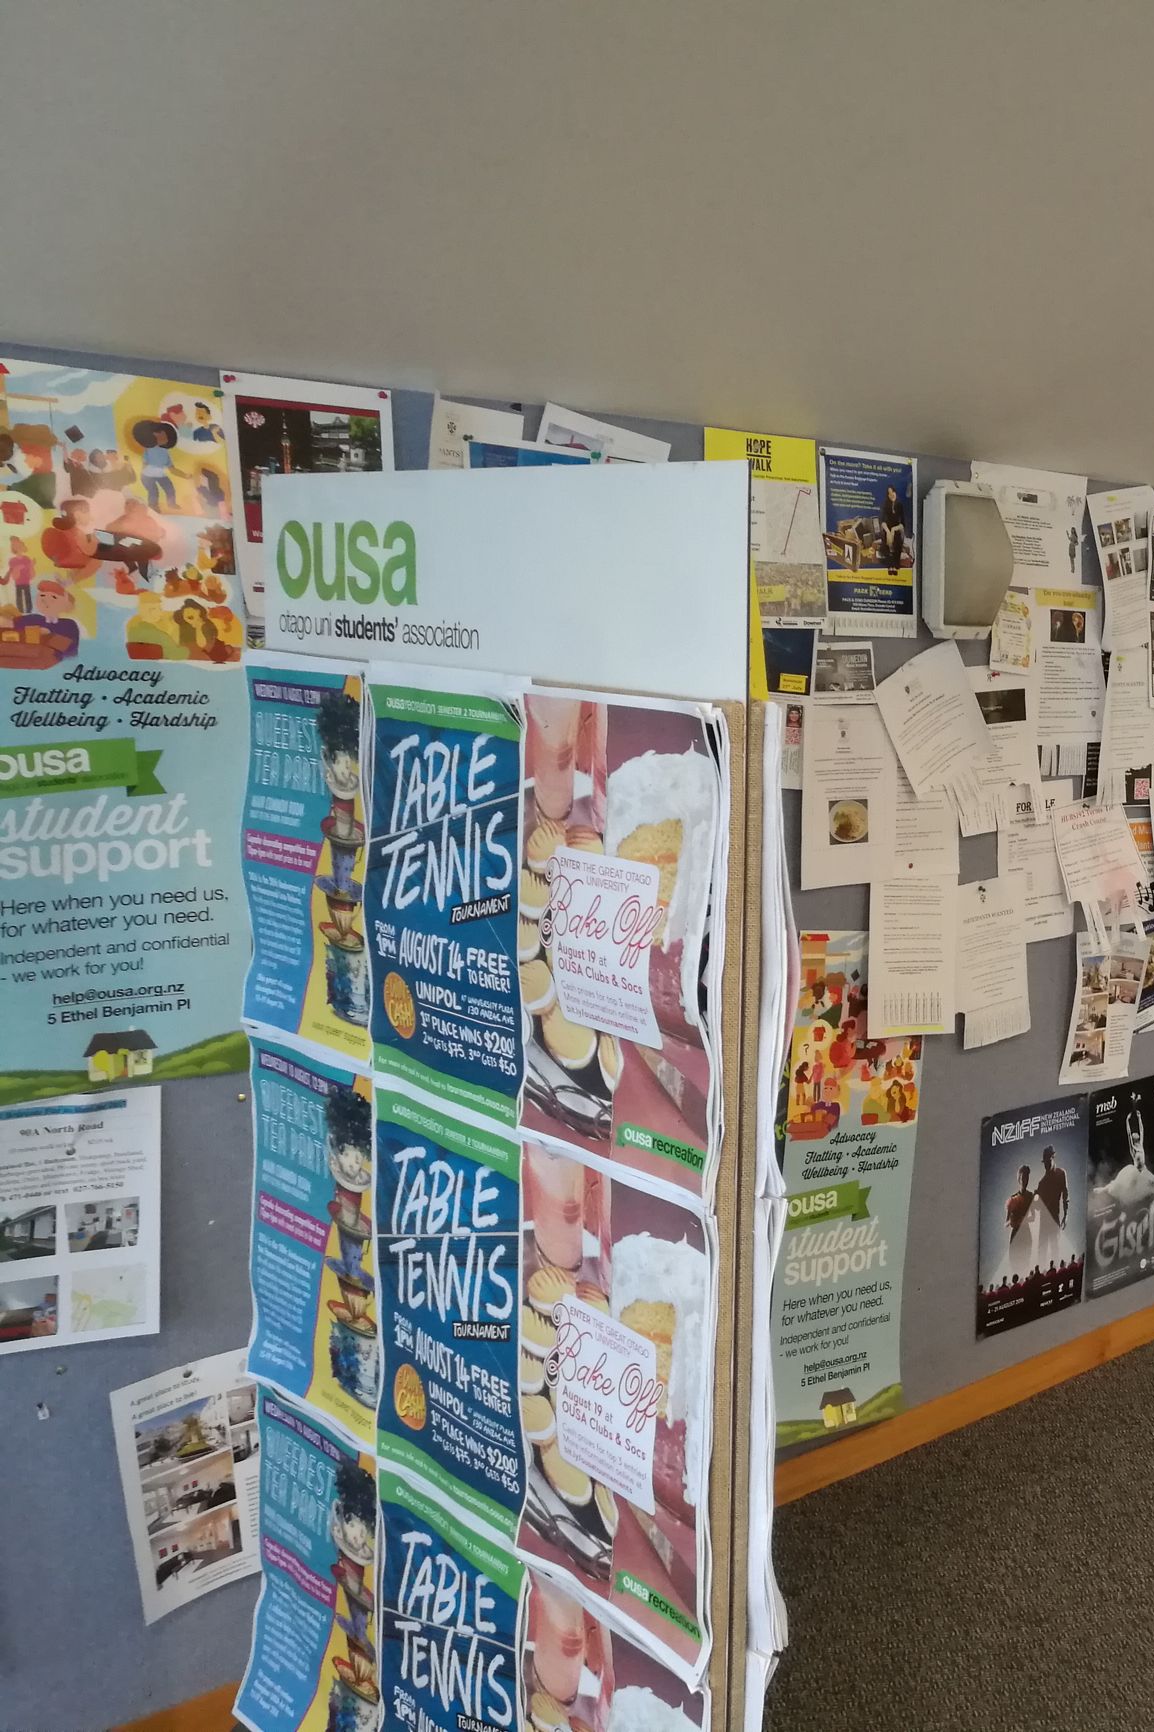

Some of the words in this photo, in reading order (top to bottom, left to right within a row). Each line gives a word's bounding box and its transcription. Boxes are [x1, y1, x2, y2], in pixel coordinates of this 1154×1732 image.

[746, 438, 772, 454] HOPE
[277, 520, 418, 606] ousa
[279, 611, 312, 640] otago
[315, 613, 332, 636] uni
[335, 614, 398, 642] students'
[402, 620, 479, 650] association
[63, 664, 164, 690] Advocacy
[13, 686, 96, 706] Flatting
[113, 687, 210, 706] Academic
[10, 711, 110, 732] Wellbeing
[129, 711, 217, 730] Hardship
[0, 748, 91, 780] ousa
[390, 734, 497, 836] TABLE
[0, 793, 188, 843] student
[1016, 802, 1032, 813] FOR
[0, 829, 212, 884] support
[382, 807, 512, 912] TENNIS
[560, 857, 580, 870] ENTER
[583, 863, 596, 873] THE
[599, 866, 624, 879] GREAT
[626, 871, 652, 886] OTAGO
[586, 876, 630, 893] UNIVERSITY
[0, 899, 46, 916] Here
[52, 895, 103, 911] when
[109, 891, 144, 911] you
[152, 887, 197, 904] need
[451, 895, 510, 923] TOURNAMENT
[0, 922, 26, 938] for
[32, 915, 117, 935] whatever
[123, 913, 157, 931] you
[164, 907, 214, 925] need.
[544, 868, 609, 945] Bake
[612, 895, 664, 969] Off
[0, 943, 101, 965] Independent
[107, 940, 137, 955] and
[141, 933, 230, 952] confidential
[399, 927, 448, 976] AUGUST
[447, 940, 464, 981] 14
[466, 947, 510, 976] FREE
[558, 941, 585, 961] August
[588, 949, 596, 963] 19
[599, 956, 607, 968] at
[12, 971, 36, 983] we
[41, 964, 80, 980] work
[85, 962, 106, 975] for
[111, 957, 145, 976] you!
[467, 968, 477, 984] TO
[479, 970, 511, 993] ENTER!
[558, 957, 583, 976] OUSA
[585, 966, 609, 984] Clubs
[612, 974, 619, 987] &
[621, 977, 643, 995] Socs
[53, 981, 184, 1005] help@ousa.org.nz
[415, 981, 462, 1010] UNIPOL
[47, 1013, 56, 1025] 5
[61, 1008, 98, 1023] Ethel
[102, 1000, 173, 1019] Benjamin
[432, 1016, 459, 1039] PLACE
[460, 1026, 482, 1046] WINS
[484, 1030, 516, 1058] $200!
[499, 1057, 517, 1076] $50
[78, 1121, 104, 1132] Road
[1041, 1113, 1053, 1121] NEW
[1053, 1107, 1076, 1119] ZEALAND
[1041, 1114, 1080, 1127] INTERNATIONAL
[1041, 1126, 1053, 1135] FILM
[1053, 1121, 1075, 1132] FESTIVAL
[830, 1131, 876, 1145] Advocacy
[991, 1116, 1041, 1147] NZIFF
[624, 1127, 704, 1169] ousarecreation
[805, 1150, 843, 1165] Flatting
[852, 1143, 897, 1159] Academic
[802, 1165, 848, 1180] Wellbeing
[858, 1158, 899, 1174] Hardship
[391, 1146, 499, 1239] TABLE
[788, 1190, 838, 1217] ousa
[787, 1216, 879, 1260] student
[389, 1233, 513, 1323] TENNIS
[784, 1239, 888, 1287] support
[783, 1298, 806, 1312] Here
[809, 1293, 834, 1306] when
[836, 1290, 852, 1303] you
[855, 1282, 877, 1296] need
[570, 1307, 591, 1324] ENTER
[605, 1326, 625, 1342] GREAT
[780, 1327, 830, 1346] Independent
[832, 1323, 846, 1335] and
[848, 1312, 891, 1331] confidential
[781, 1315, 795, 1327] for
[797, 1306, 839, 1323] whatever
[841, 1303, 858, 1317] you
[453, 1323, 511, 1339] TOURNAMENT
[785, 1349, 797, 1358] we
[800, 1342, 819, 1355] work
[821, 1339, 831, 1350] for
[415, 1327, 454, 1382] AUGUST
[454, 1354, 470, 1393] 14
[471, 1365, 511, 1401] FREE
[550, 1316, 615, 1395] Bake
[618, 1363, 663, 1433] Off
[807, 1373, 826, 1386] Ethel
[828, 1366, 861, 1381] Benjamin
[428, 1380, 468, 1420] UNIPOL
[562, 1385, 592, 1412] August
[594, 1402, 603, 1417] 19
[605, 1410, 613, 1424] at
[442, 1418, 464, 1447] PLACE
[465, 1434, 486, 1460] WINS
[562, 1400, 587, 1426] OUSA
[589, 1418, 613, 1441] Clubs
[615, 1433, 622, 1445] &
[625, 1439, 646, 1461] Socs
[398, 1531, 497, 1636] TABLE
[394, 1620, 513, 1727] TENNIS
